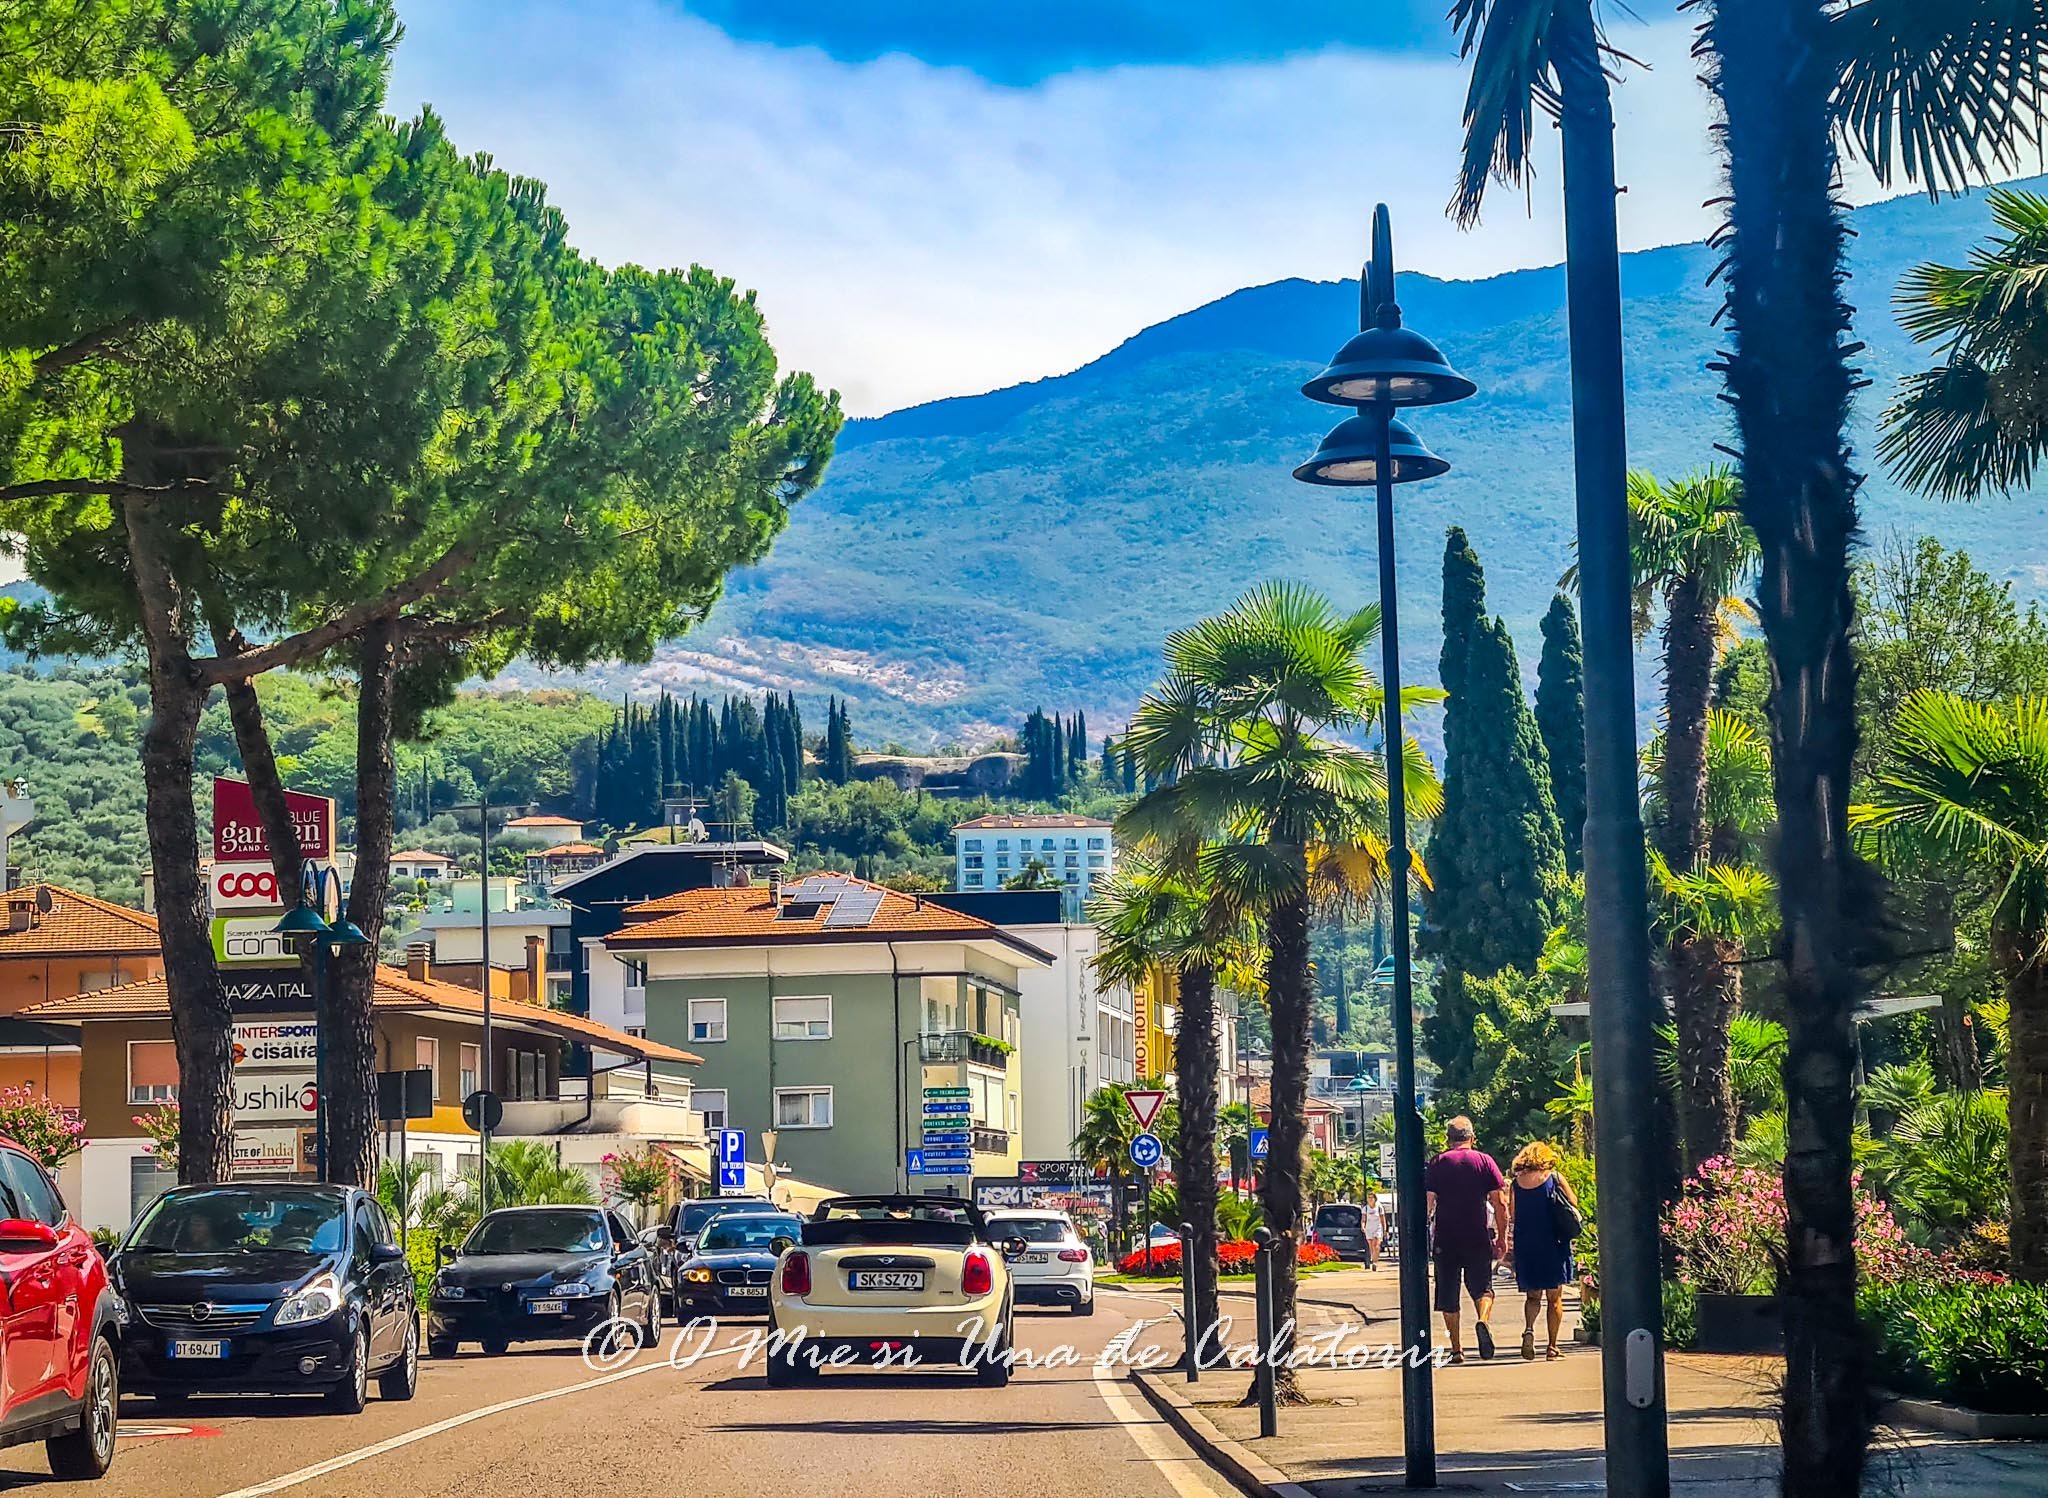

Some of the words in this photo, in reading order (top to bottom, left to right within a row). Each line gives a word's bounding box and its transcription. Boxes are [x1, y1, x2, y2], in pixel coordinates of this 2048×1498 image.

[222, 820, 321, 853] garen
[238, 844, 260, 852] LAND
[225, 983, 276, 1000] IAZZA
[278, 982, 312, 998] ITAL
[1134, 990, 1146, 1040] HOTEL
[238, 1025, 318, 1039] INTERSPORT
[252, 1042, 318, 1059] cisalfa
[234, 1082, 318, 1112] ushiko
[233, 1148, 249, 1157] STE
[250, 1148, 261, 1157] OF
[262, 1142, 294, 1157] India
[726, 1132, 739, 1162] P
[1040, 1162, 1071, 1174] SPORT
